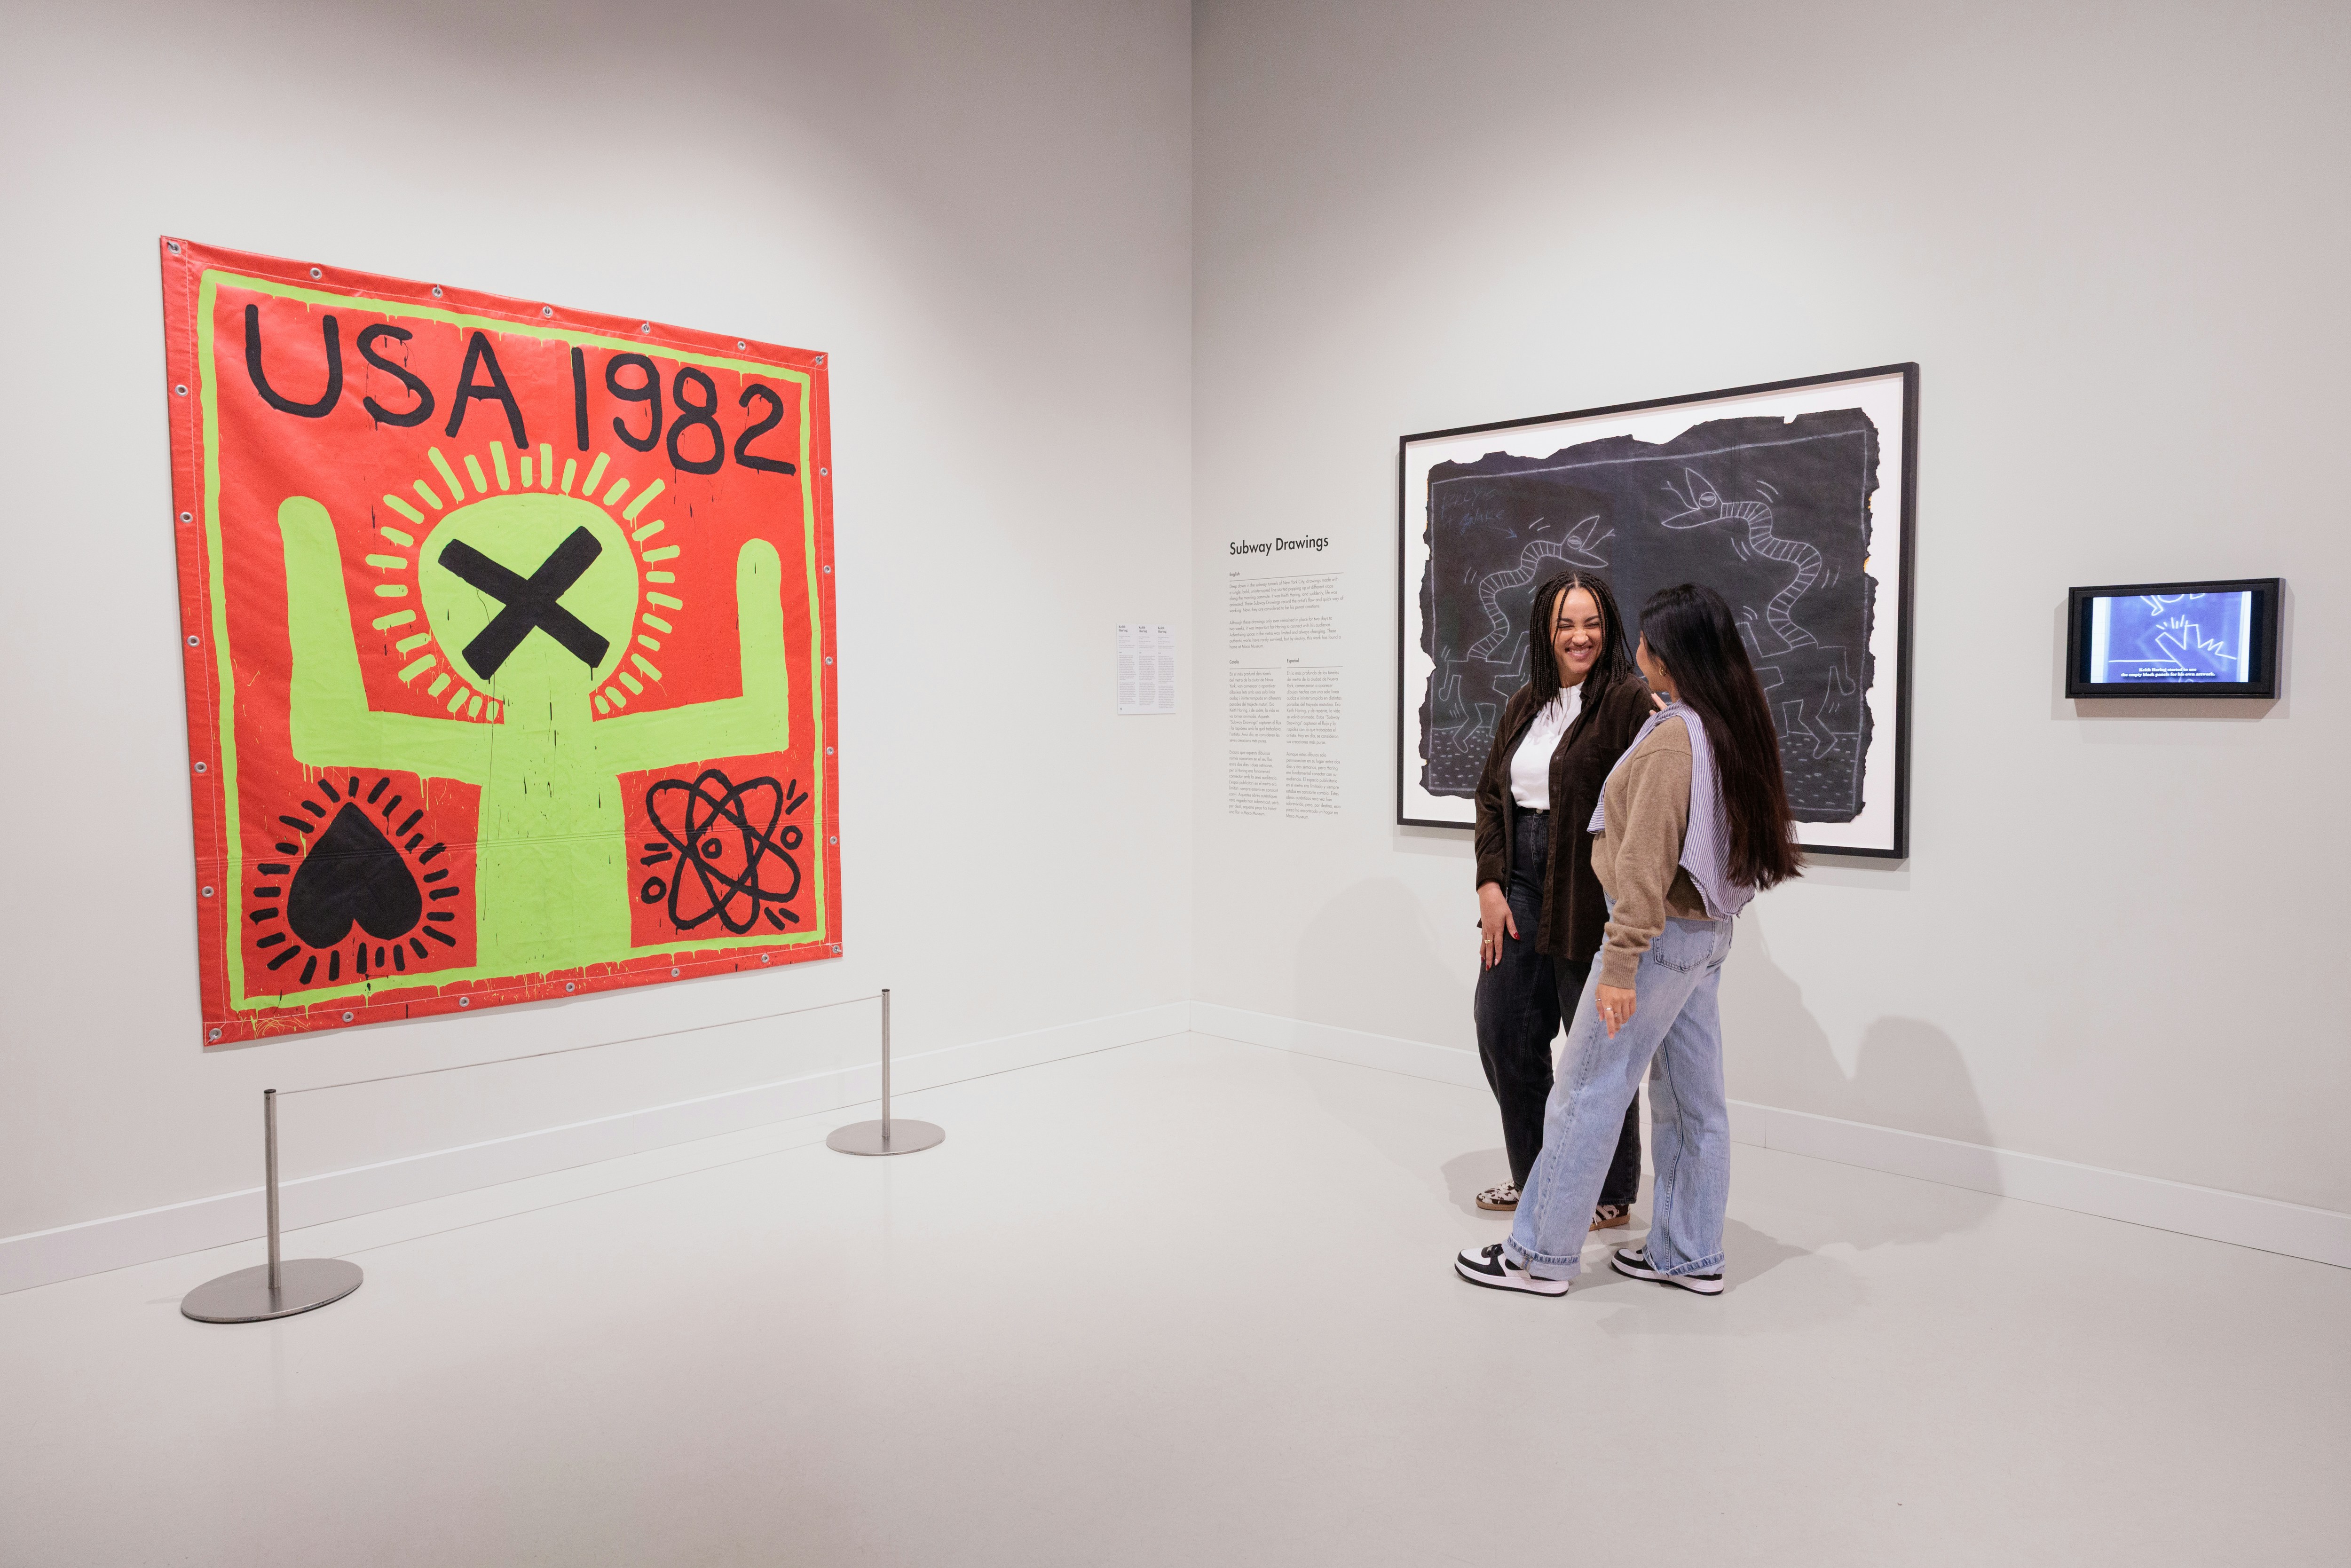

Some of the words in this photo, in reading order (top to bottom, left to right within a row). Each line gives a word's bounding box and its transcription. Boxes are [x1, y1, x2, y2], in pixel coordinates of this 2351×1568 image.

[245, 304, 529, 449] USA
[571, 347, 797, 475] 1982
[1230, 540, 1272, 556] Subway
[1276, 535, 1329, 552] Drawings
